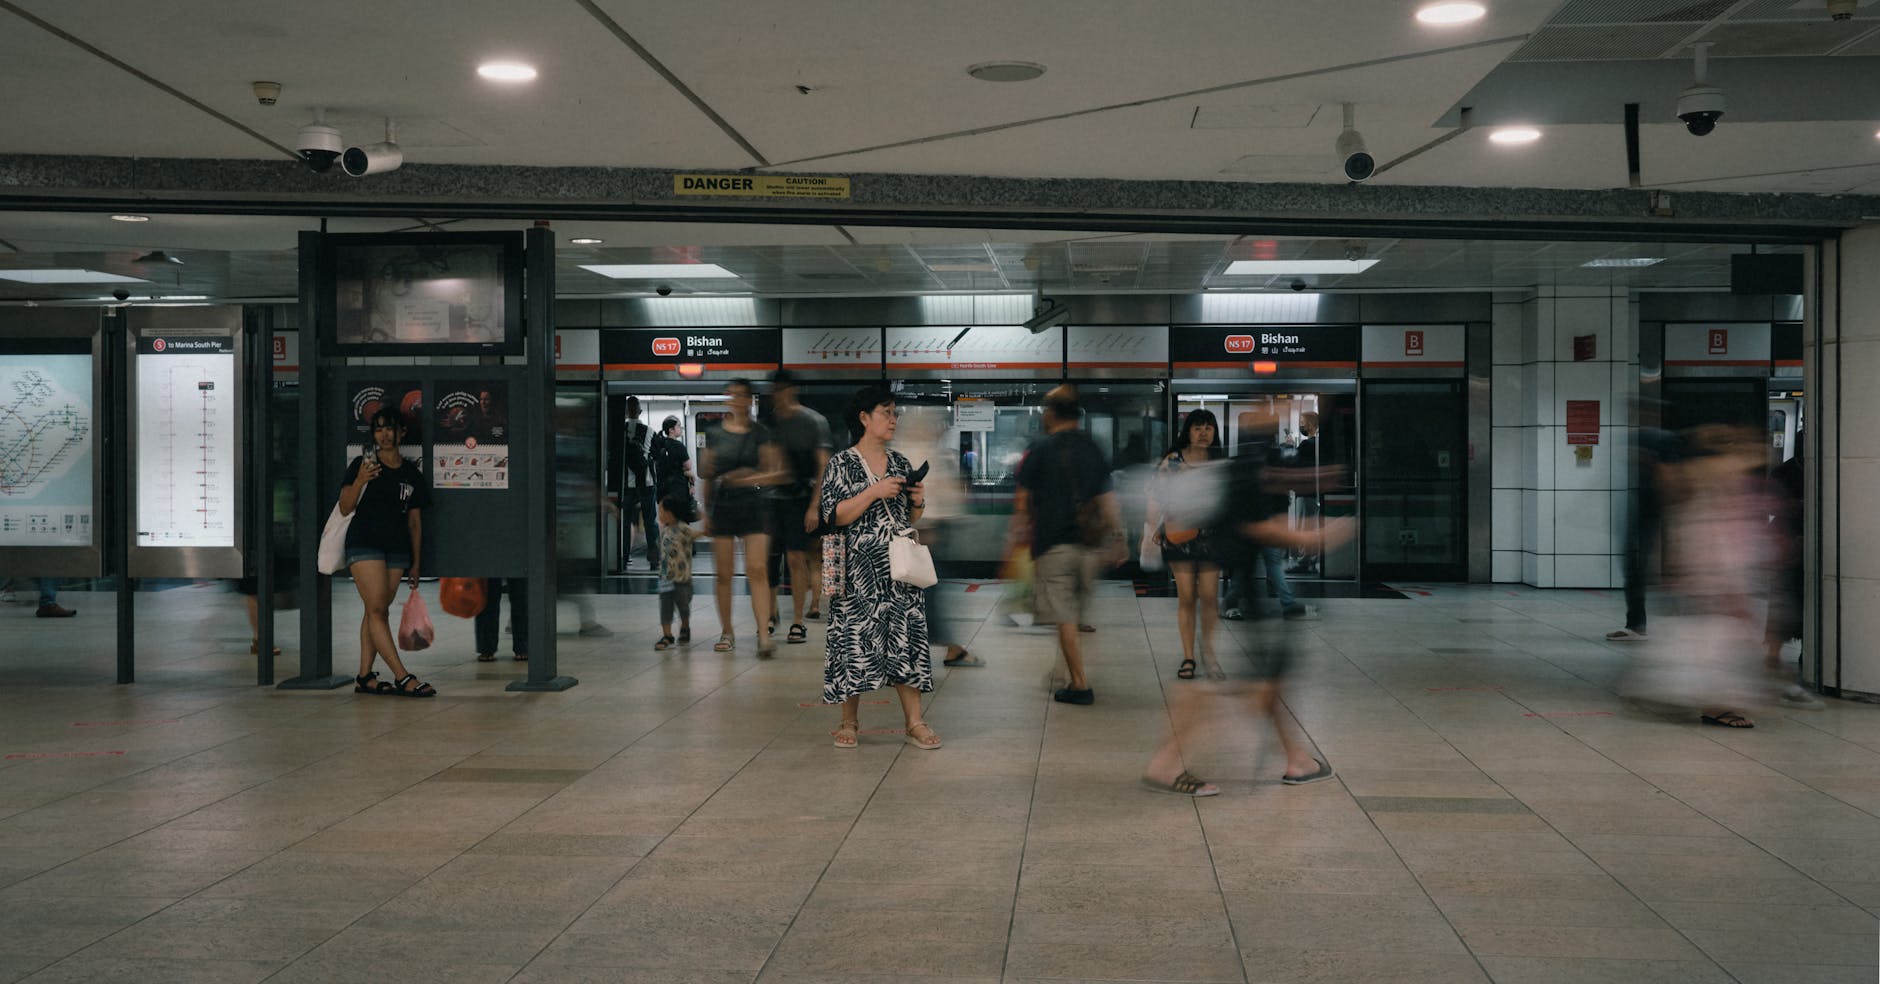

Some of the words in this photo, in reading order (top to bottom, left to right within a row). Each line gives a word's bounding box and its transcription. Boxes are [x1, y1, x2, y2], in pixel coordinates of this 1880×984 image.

[684, 177, 753, 190] DANGER
[686, 336, 722, 347] Bishan
[1229, 340, 1240, 348] NS
[1241, 340, 1251, 348] 17
[1261, 333, 1299, 344] Bishan
[1410, 335, 1419, 348] B
[1714, 333, 1722, 346] B
[273, 341, 281, 353] B
[656, 343, 667, 351] NS
[667, 343, 677, 351] 17
